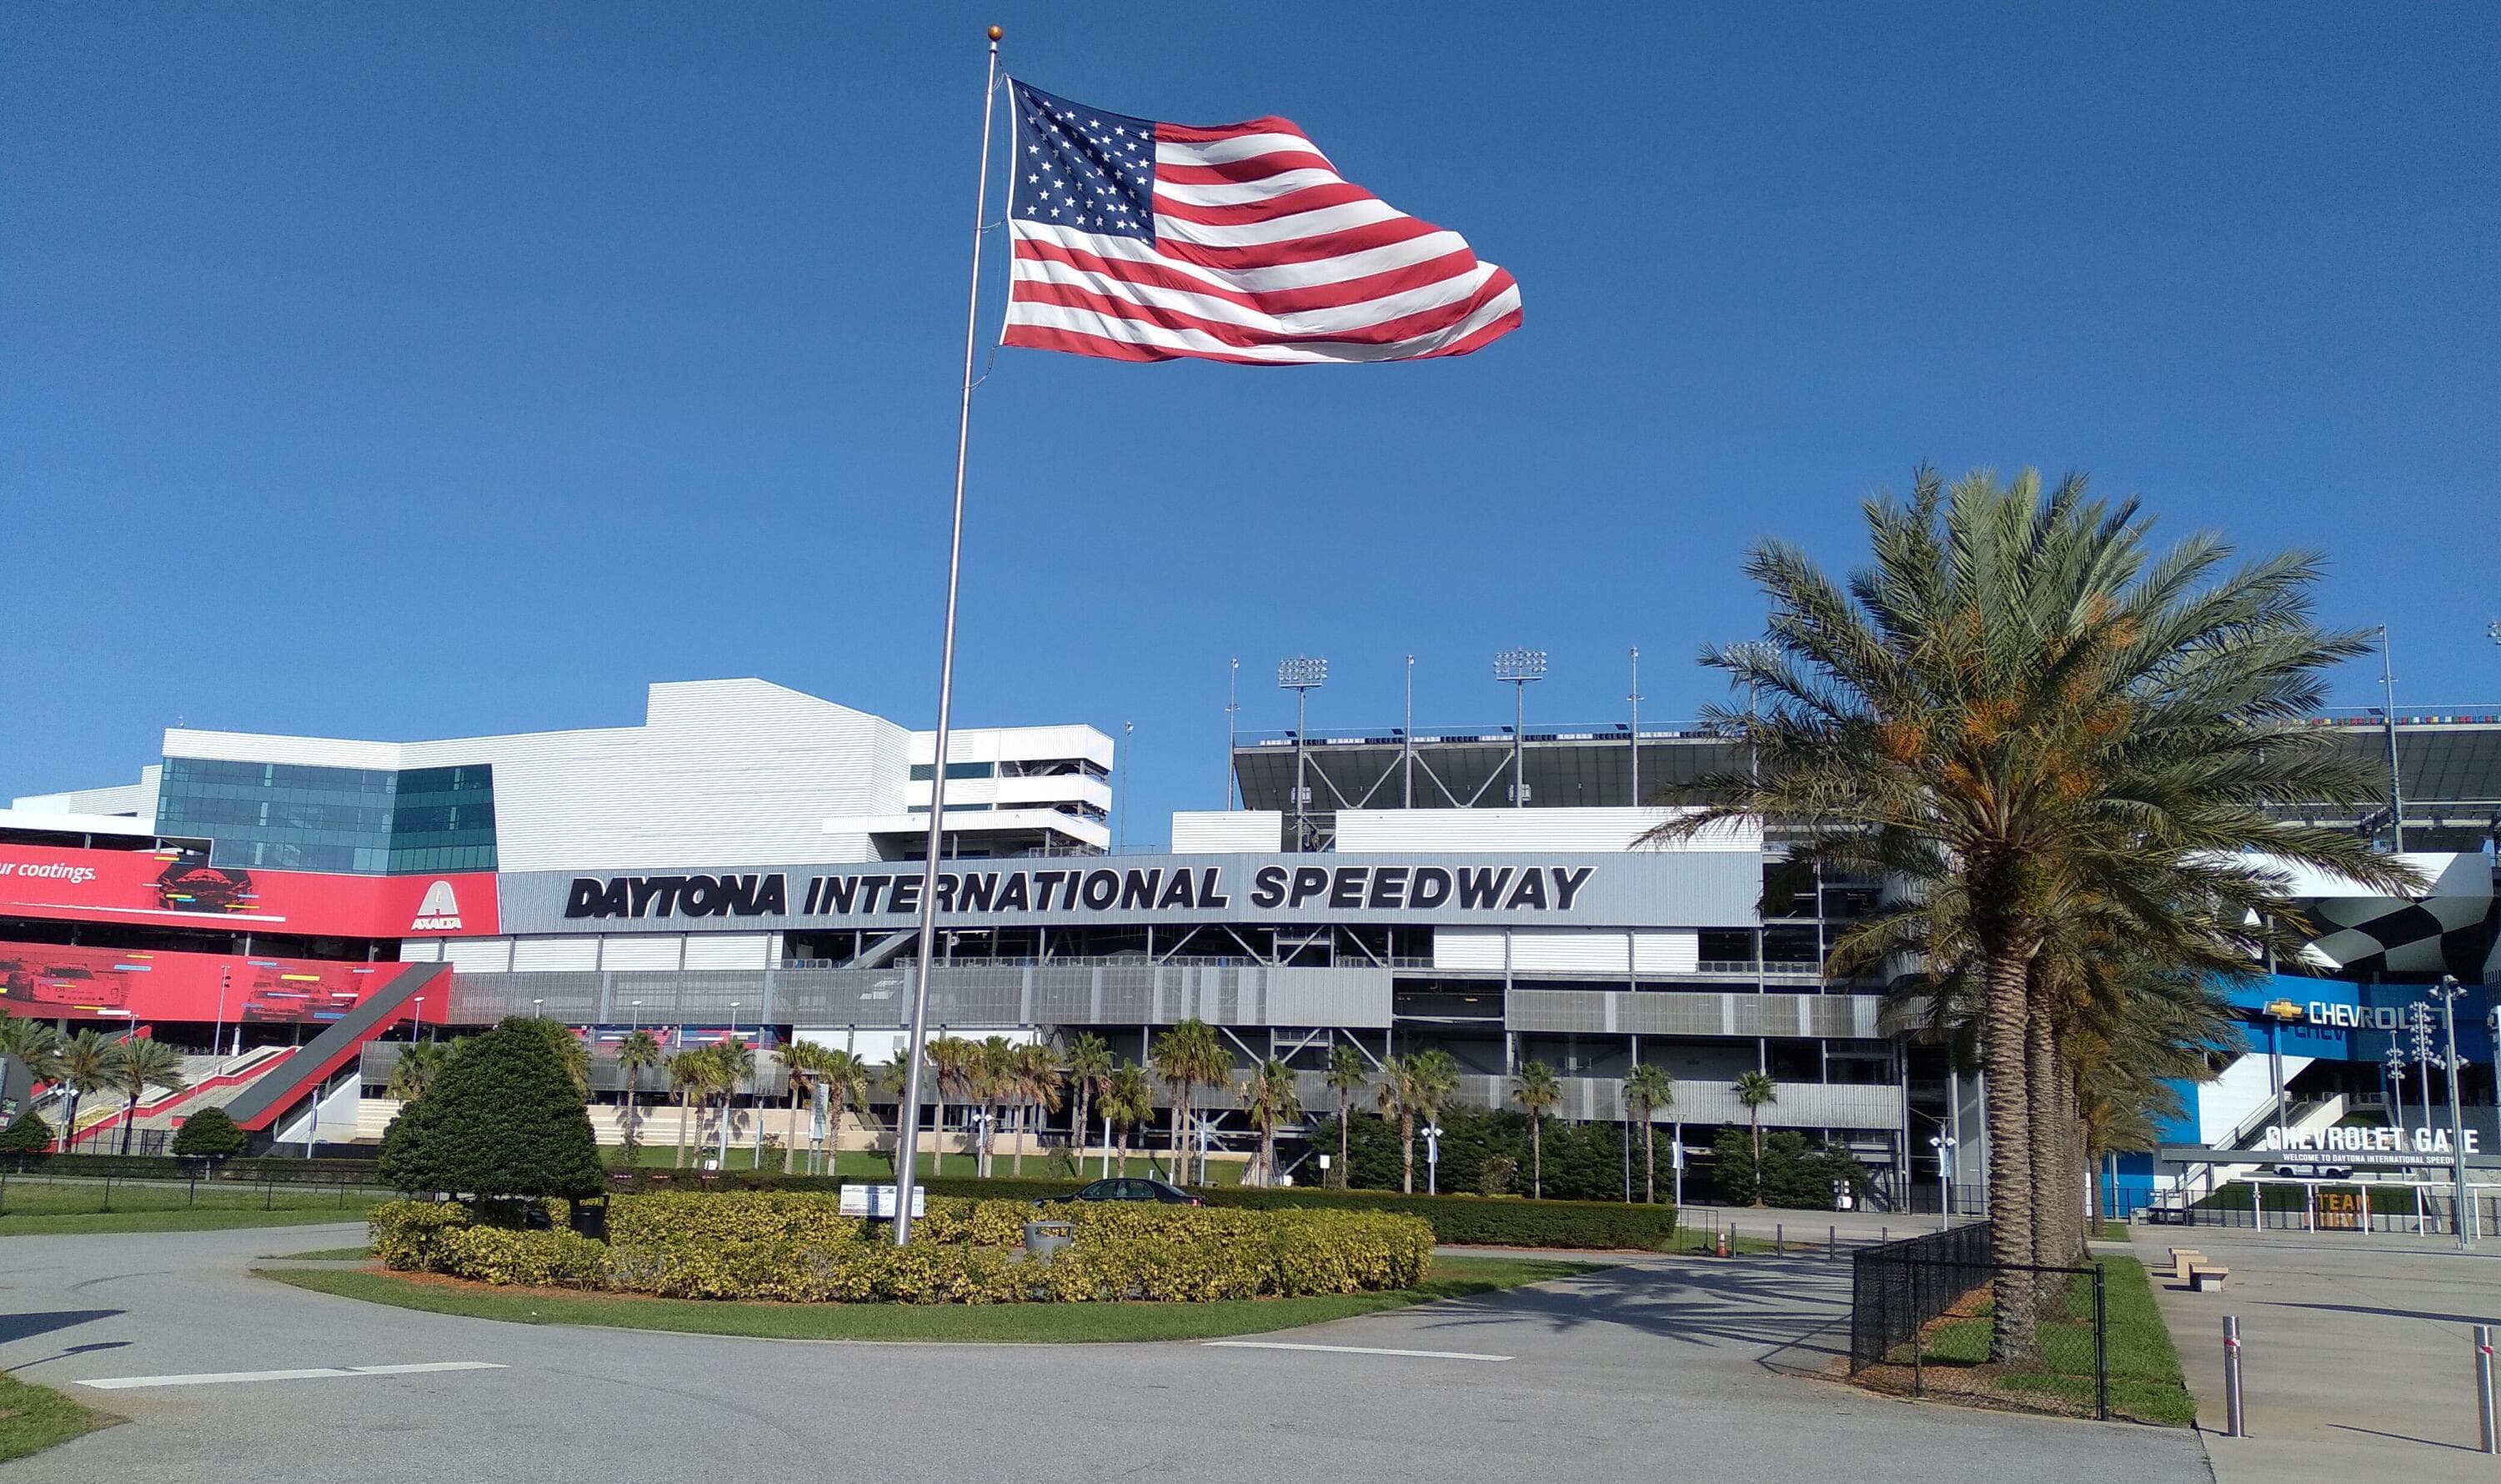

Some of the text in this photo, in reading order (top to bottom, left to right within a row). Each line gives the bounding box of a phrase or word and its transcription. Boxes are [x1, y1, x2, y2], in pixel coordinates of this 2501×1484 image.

[18, 863, 97, 884] coatings.
[564, 865, 1598, 920] DAYTONA INTERNATIONAL SPEEDWAY
[411, 917, 463, 930] AXALTA
[2265, 1126, 2480, 1154] CHEVROLET GAE
[2283, 1153, 2467, 1165] WELCOME TO DAYTONA INTERNATIONAL SPEED
[2316, 1193, 2373, 1211] TEAM
